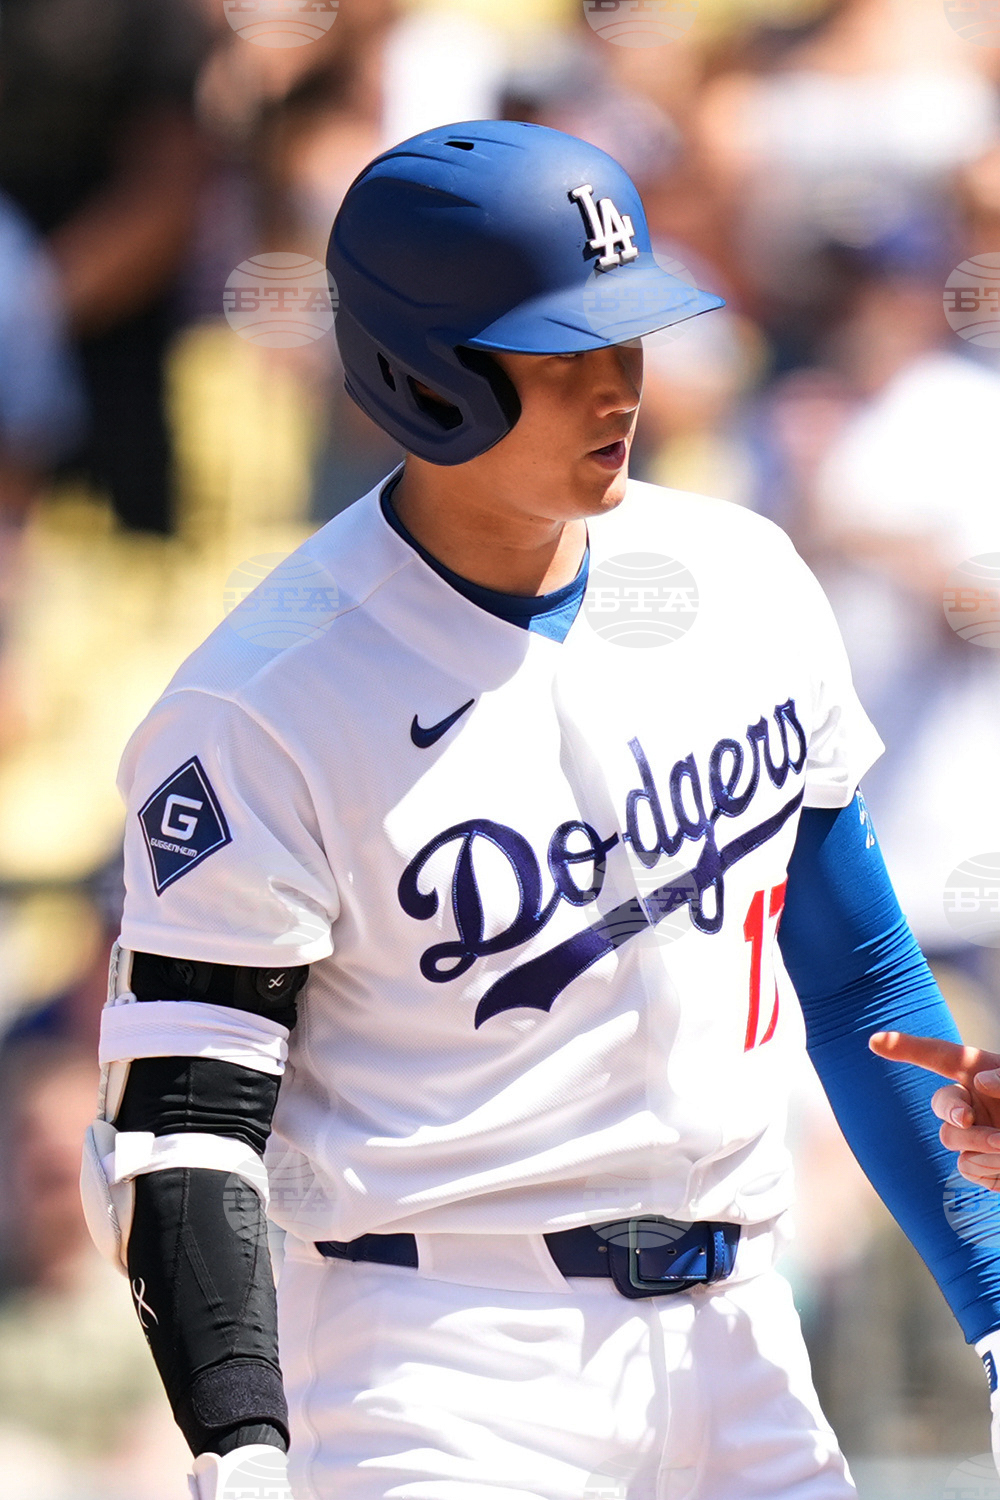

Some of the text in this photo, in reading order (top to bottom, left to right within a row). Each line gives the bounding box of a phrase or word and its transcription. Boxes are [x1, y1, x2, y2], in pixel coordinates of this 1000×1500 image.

[571, 184, 638, 267] LA
[161, 793, 203, 841] G
[398, 697, 808, 983] Dodgers
